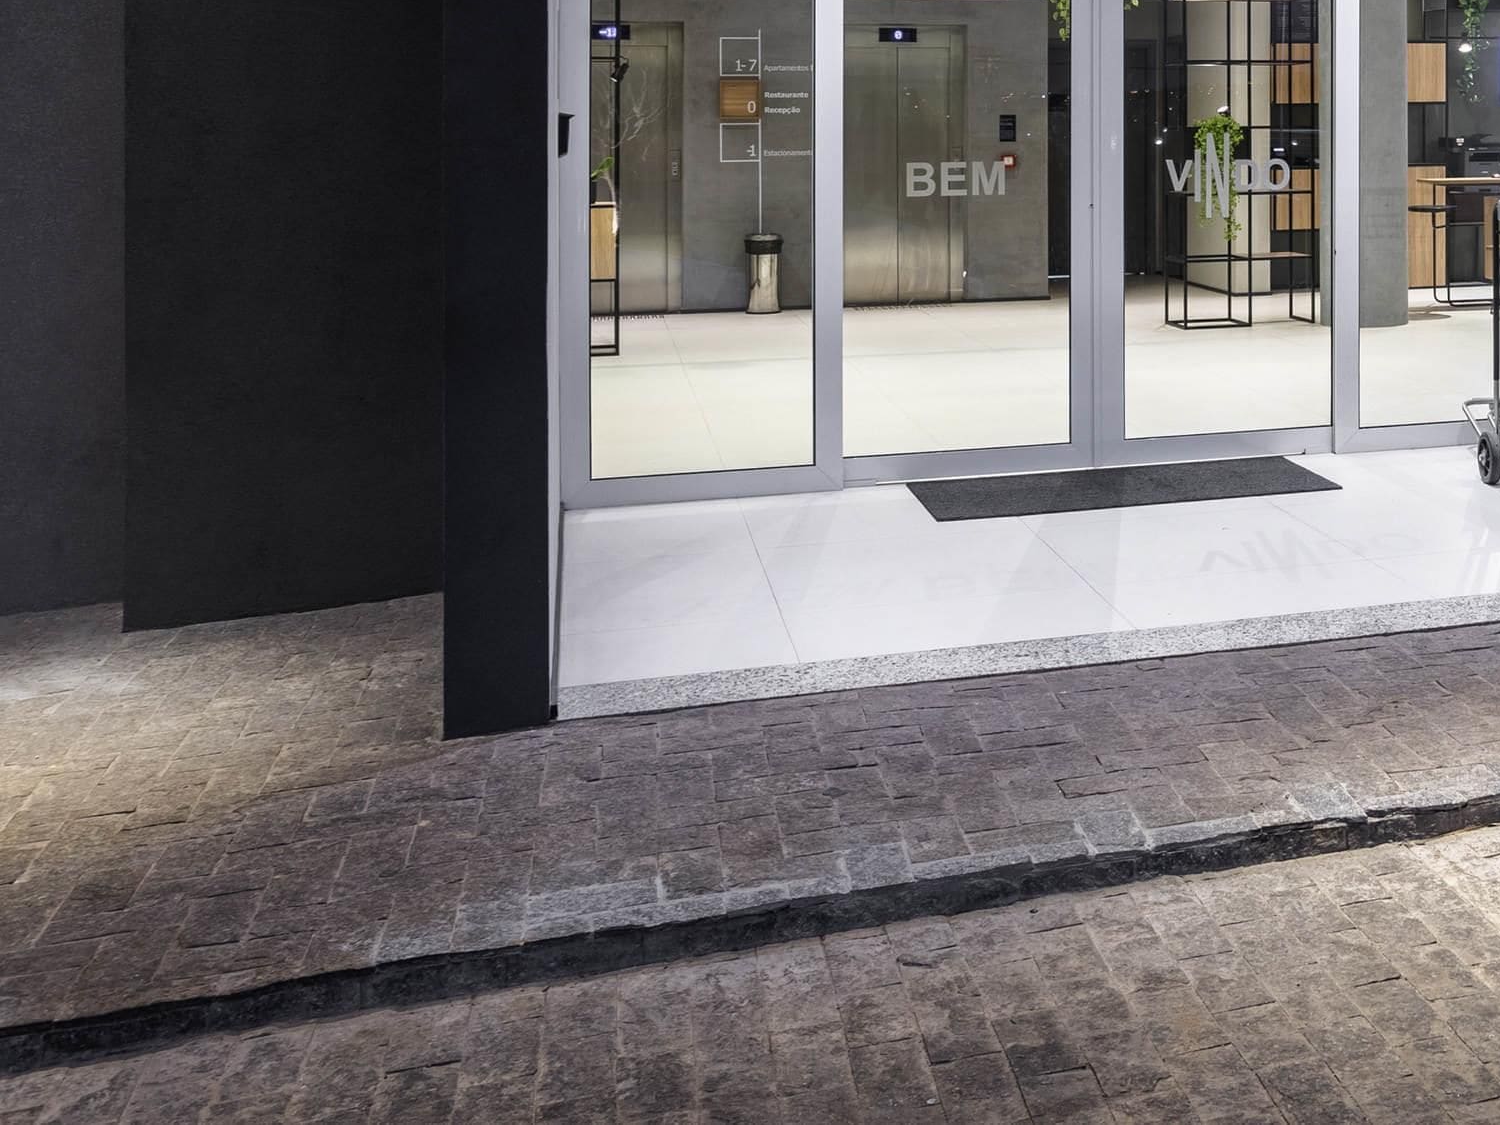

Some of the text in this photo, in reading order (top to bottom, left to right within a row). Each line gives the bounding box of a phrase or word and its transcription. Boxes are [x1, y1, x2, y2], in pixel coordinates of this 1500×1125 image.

[763, 64, 809, 72] Apartamentos
[764, 91, 809, 99] Restaurante
[747, 100, 756, 114] 0
[764, 106, 800, 115] Recepção
[905, 161, 1006, 197] BEM
[1165, 132, 1290, 219] VINDO
